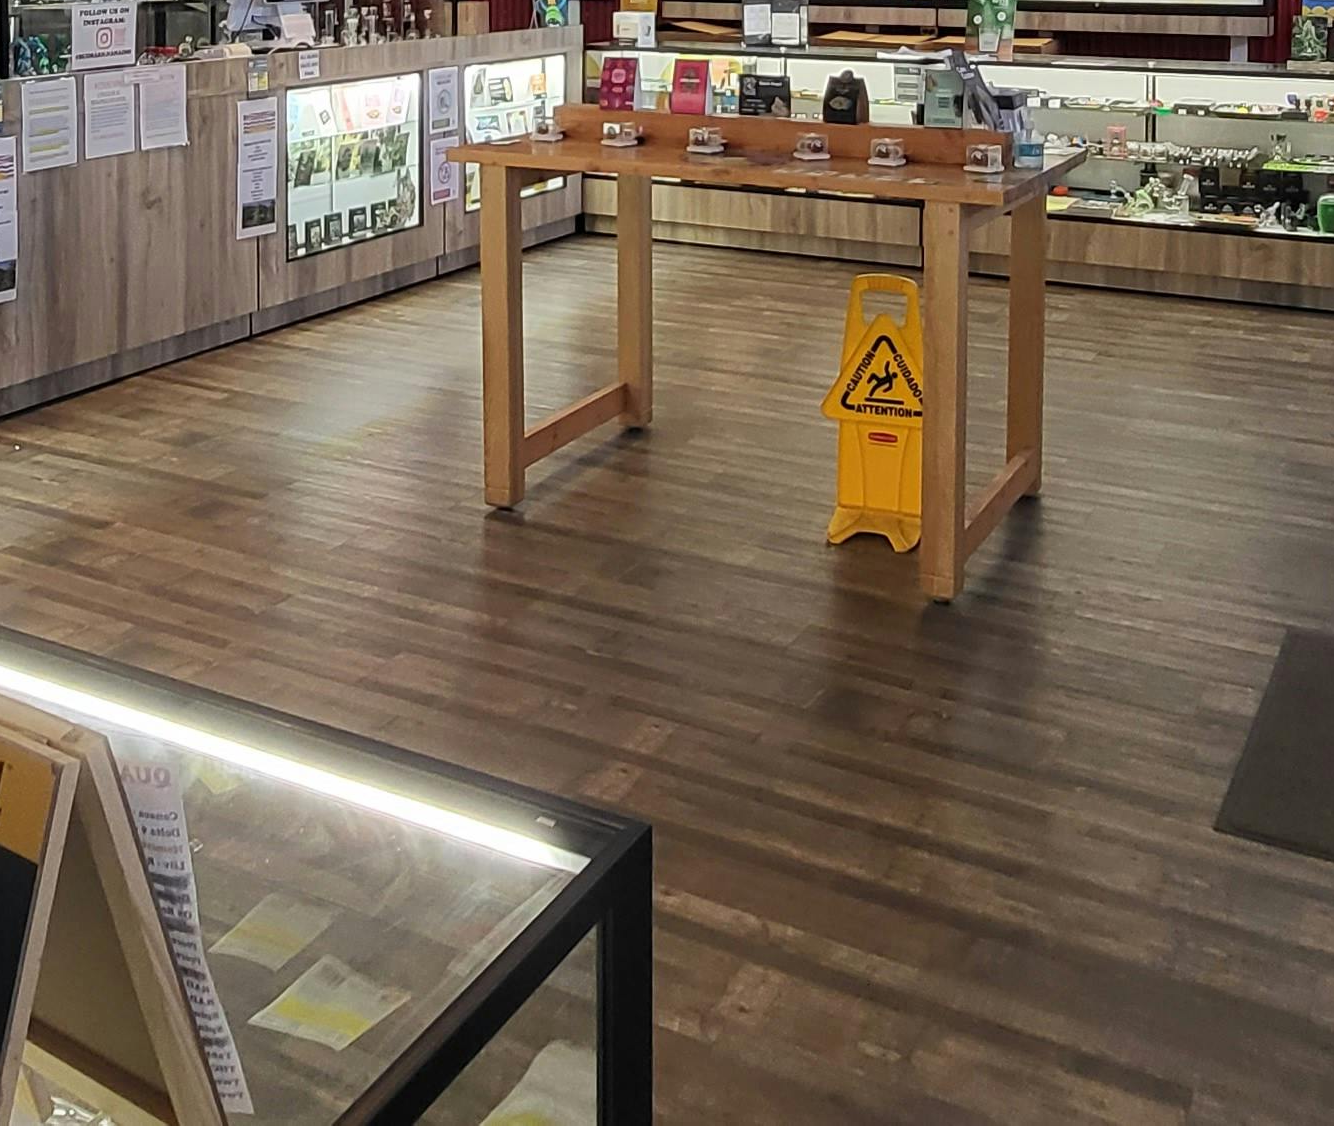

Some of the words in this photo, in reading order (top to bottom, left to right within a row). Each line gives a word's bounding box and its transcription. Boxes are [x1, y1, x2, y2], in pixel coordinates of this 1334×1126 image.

[79, 8, 108, 17] FOLLOW
[846, 350, 877, 393] CAUTION
[892, 353, 923, 399] CUIDADO
[855, 403, 913, 418] ATTENTION
